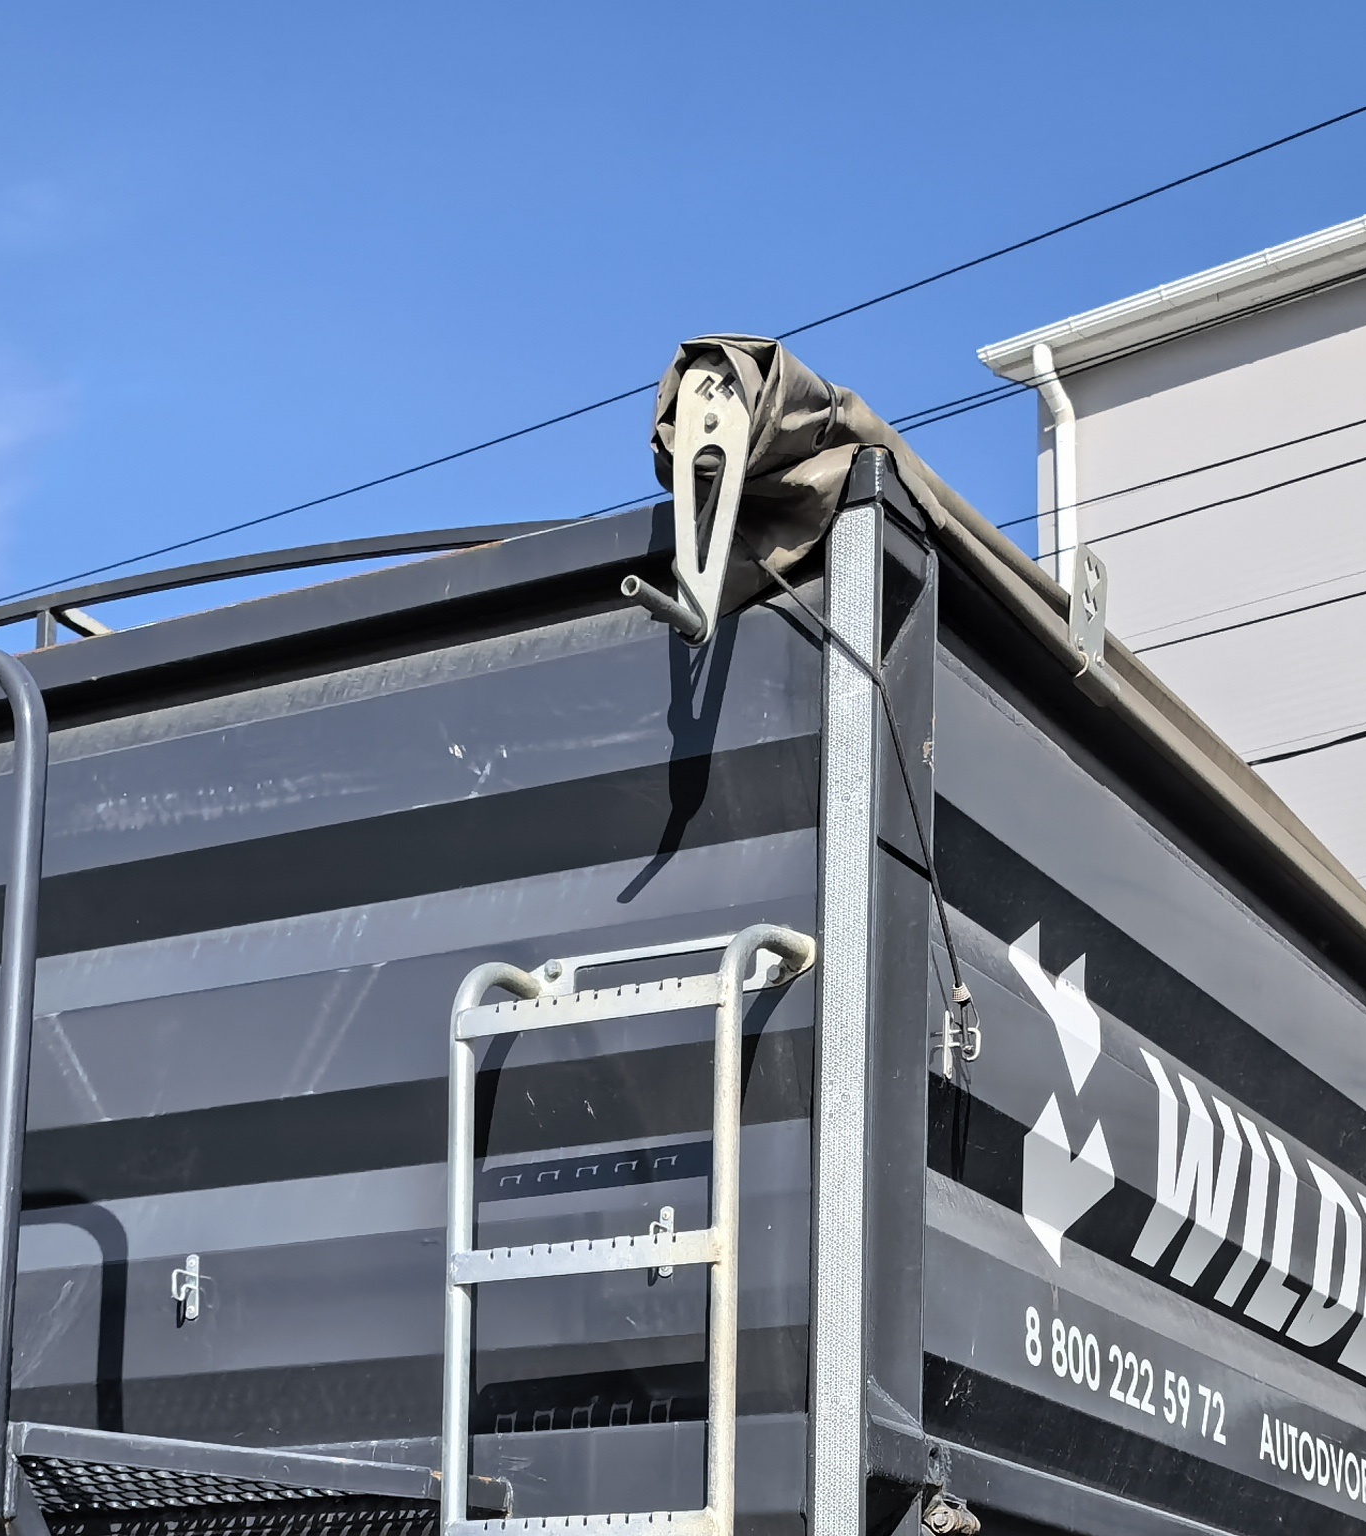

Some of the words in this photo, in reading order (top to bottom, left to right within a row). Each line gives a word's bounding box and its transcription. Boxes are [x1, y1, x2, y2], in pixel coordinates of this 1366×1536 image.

[1025, 1306, 1042, 1366] 8
[1052, 1318, 1100, 1391] 800
[1109, 1344, 1155, 1415] 222
[1163, 1369, 1190, 1428] 59
[1198, 1384, 1226, 1445] 72
